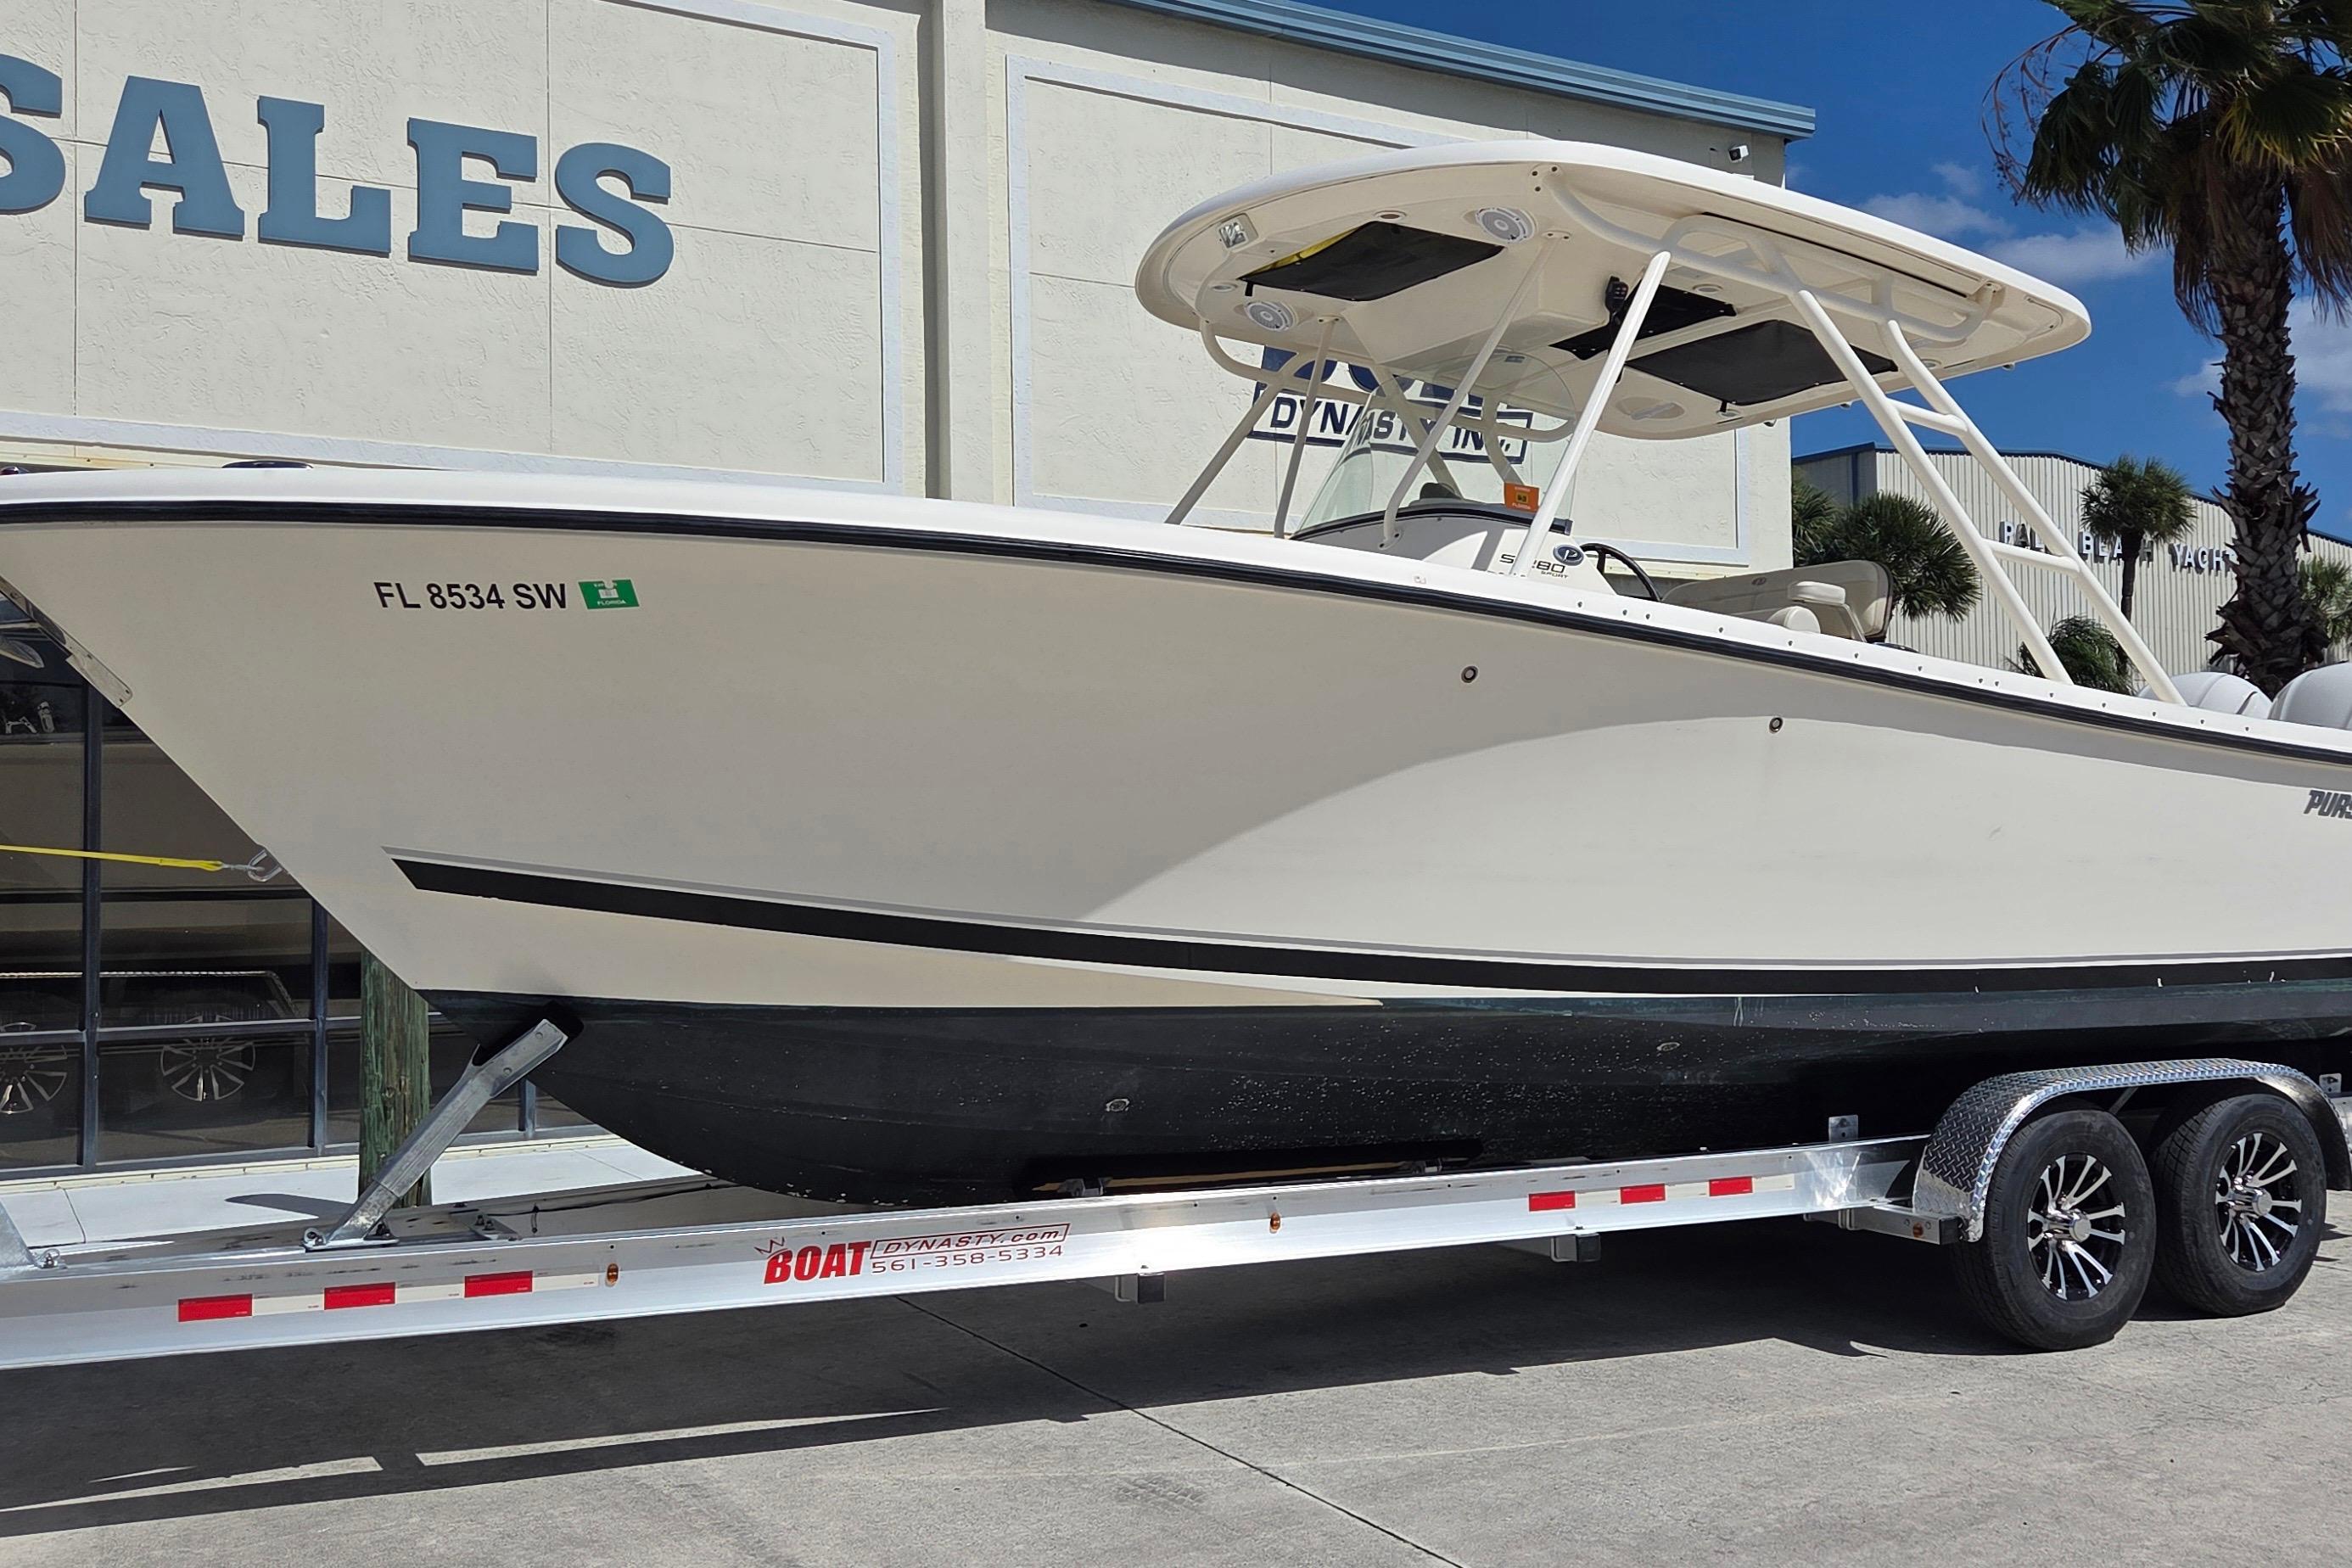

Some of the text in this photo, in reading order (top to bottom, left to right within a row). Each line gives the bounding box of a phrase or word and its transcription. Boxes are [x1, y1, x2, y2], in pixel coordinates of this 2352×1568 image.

[2000, 521, 2064, 553] PAL
[2079, 531, 2153, 561] BEAH
[373, 581, 567, 609] FL 8534 SW
[764, 1229, 1060, 1285] BOAT DYNASTY.com
[871, 1245, 1063, 1274] 561-358-5334
